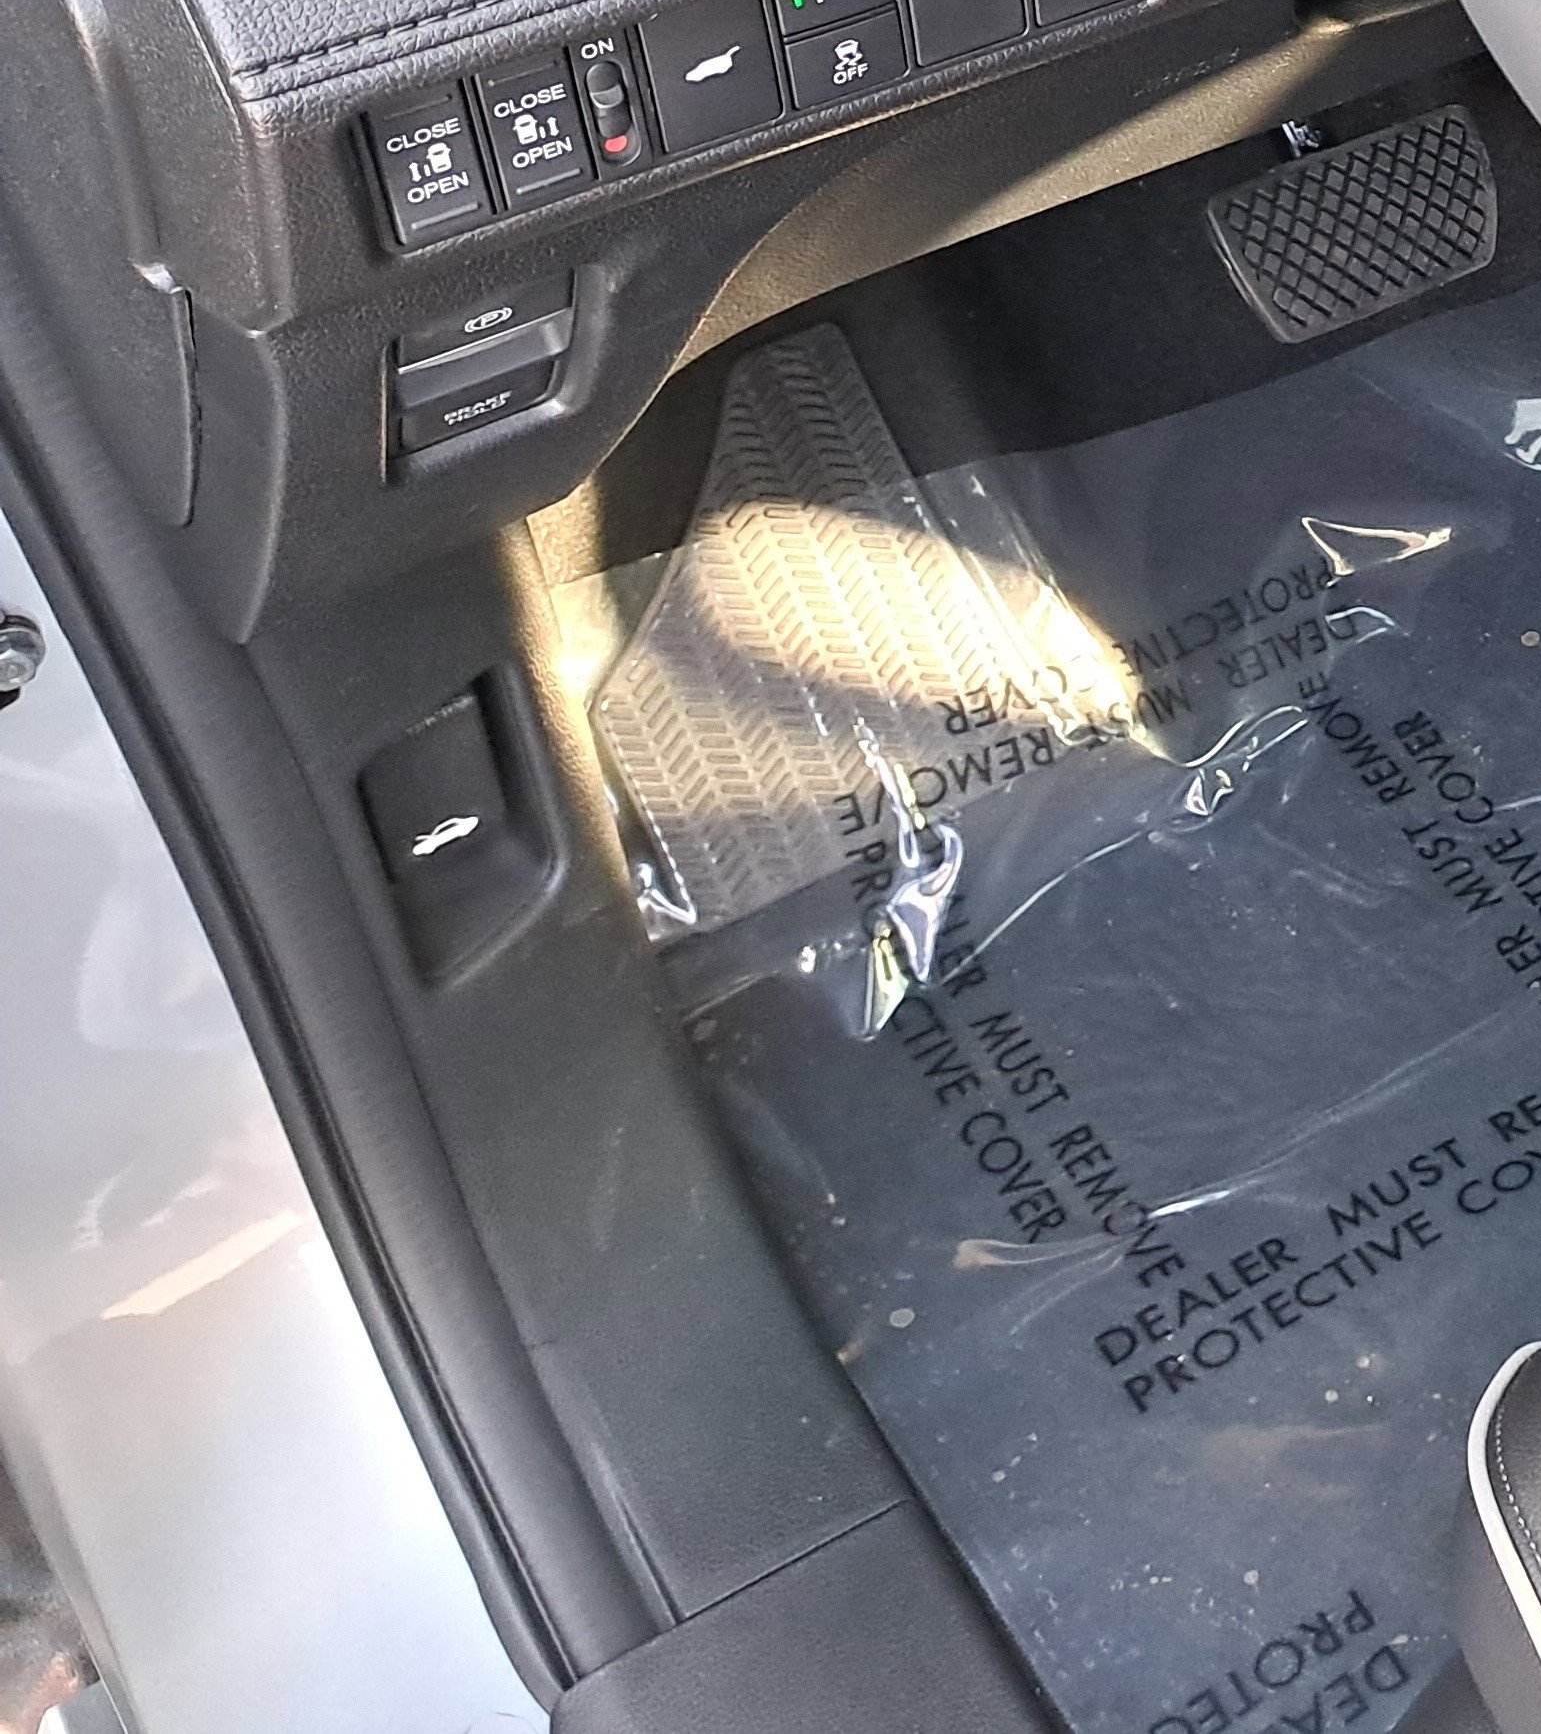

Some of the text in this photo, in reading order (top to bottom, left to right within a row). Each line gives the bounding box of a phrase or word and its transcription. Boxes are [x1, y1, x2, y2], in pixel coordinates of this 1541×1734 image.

[580, 38, 615, 60] ON
[833, 63, 869, 86] OFF
[386, 117, 461, 153] CLOSE
[493, 83, 567, 119] CLOSE
[407, 171, 469, 203] OPEN
[512, 137, 573, 169] OPEN
[1216, 610, 1360, 688] DEALER
[1299, 669, 1416, 806] REMOVE
[1394, 710, 1496, 824] COVER
[1401, 820, 1503, 914] MUST
[961, 1110, 1066, 1243] COVER
[967, 1012, 1070, 1113] MUST
[1049, 1124, 1186, 1288] REMOVE
[1094, 1237, 1297, 1367] DEALER
[1325, 1137, 1467, 1237] MUST
[1123, 1210, 1444, 1412] PROTECTIVE
